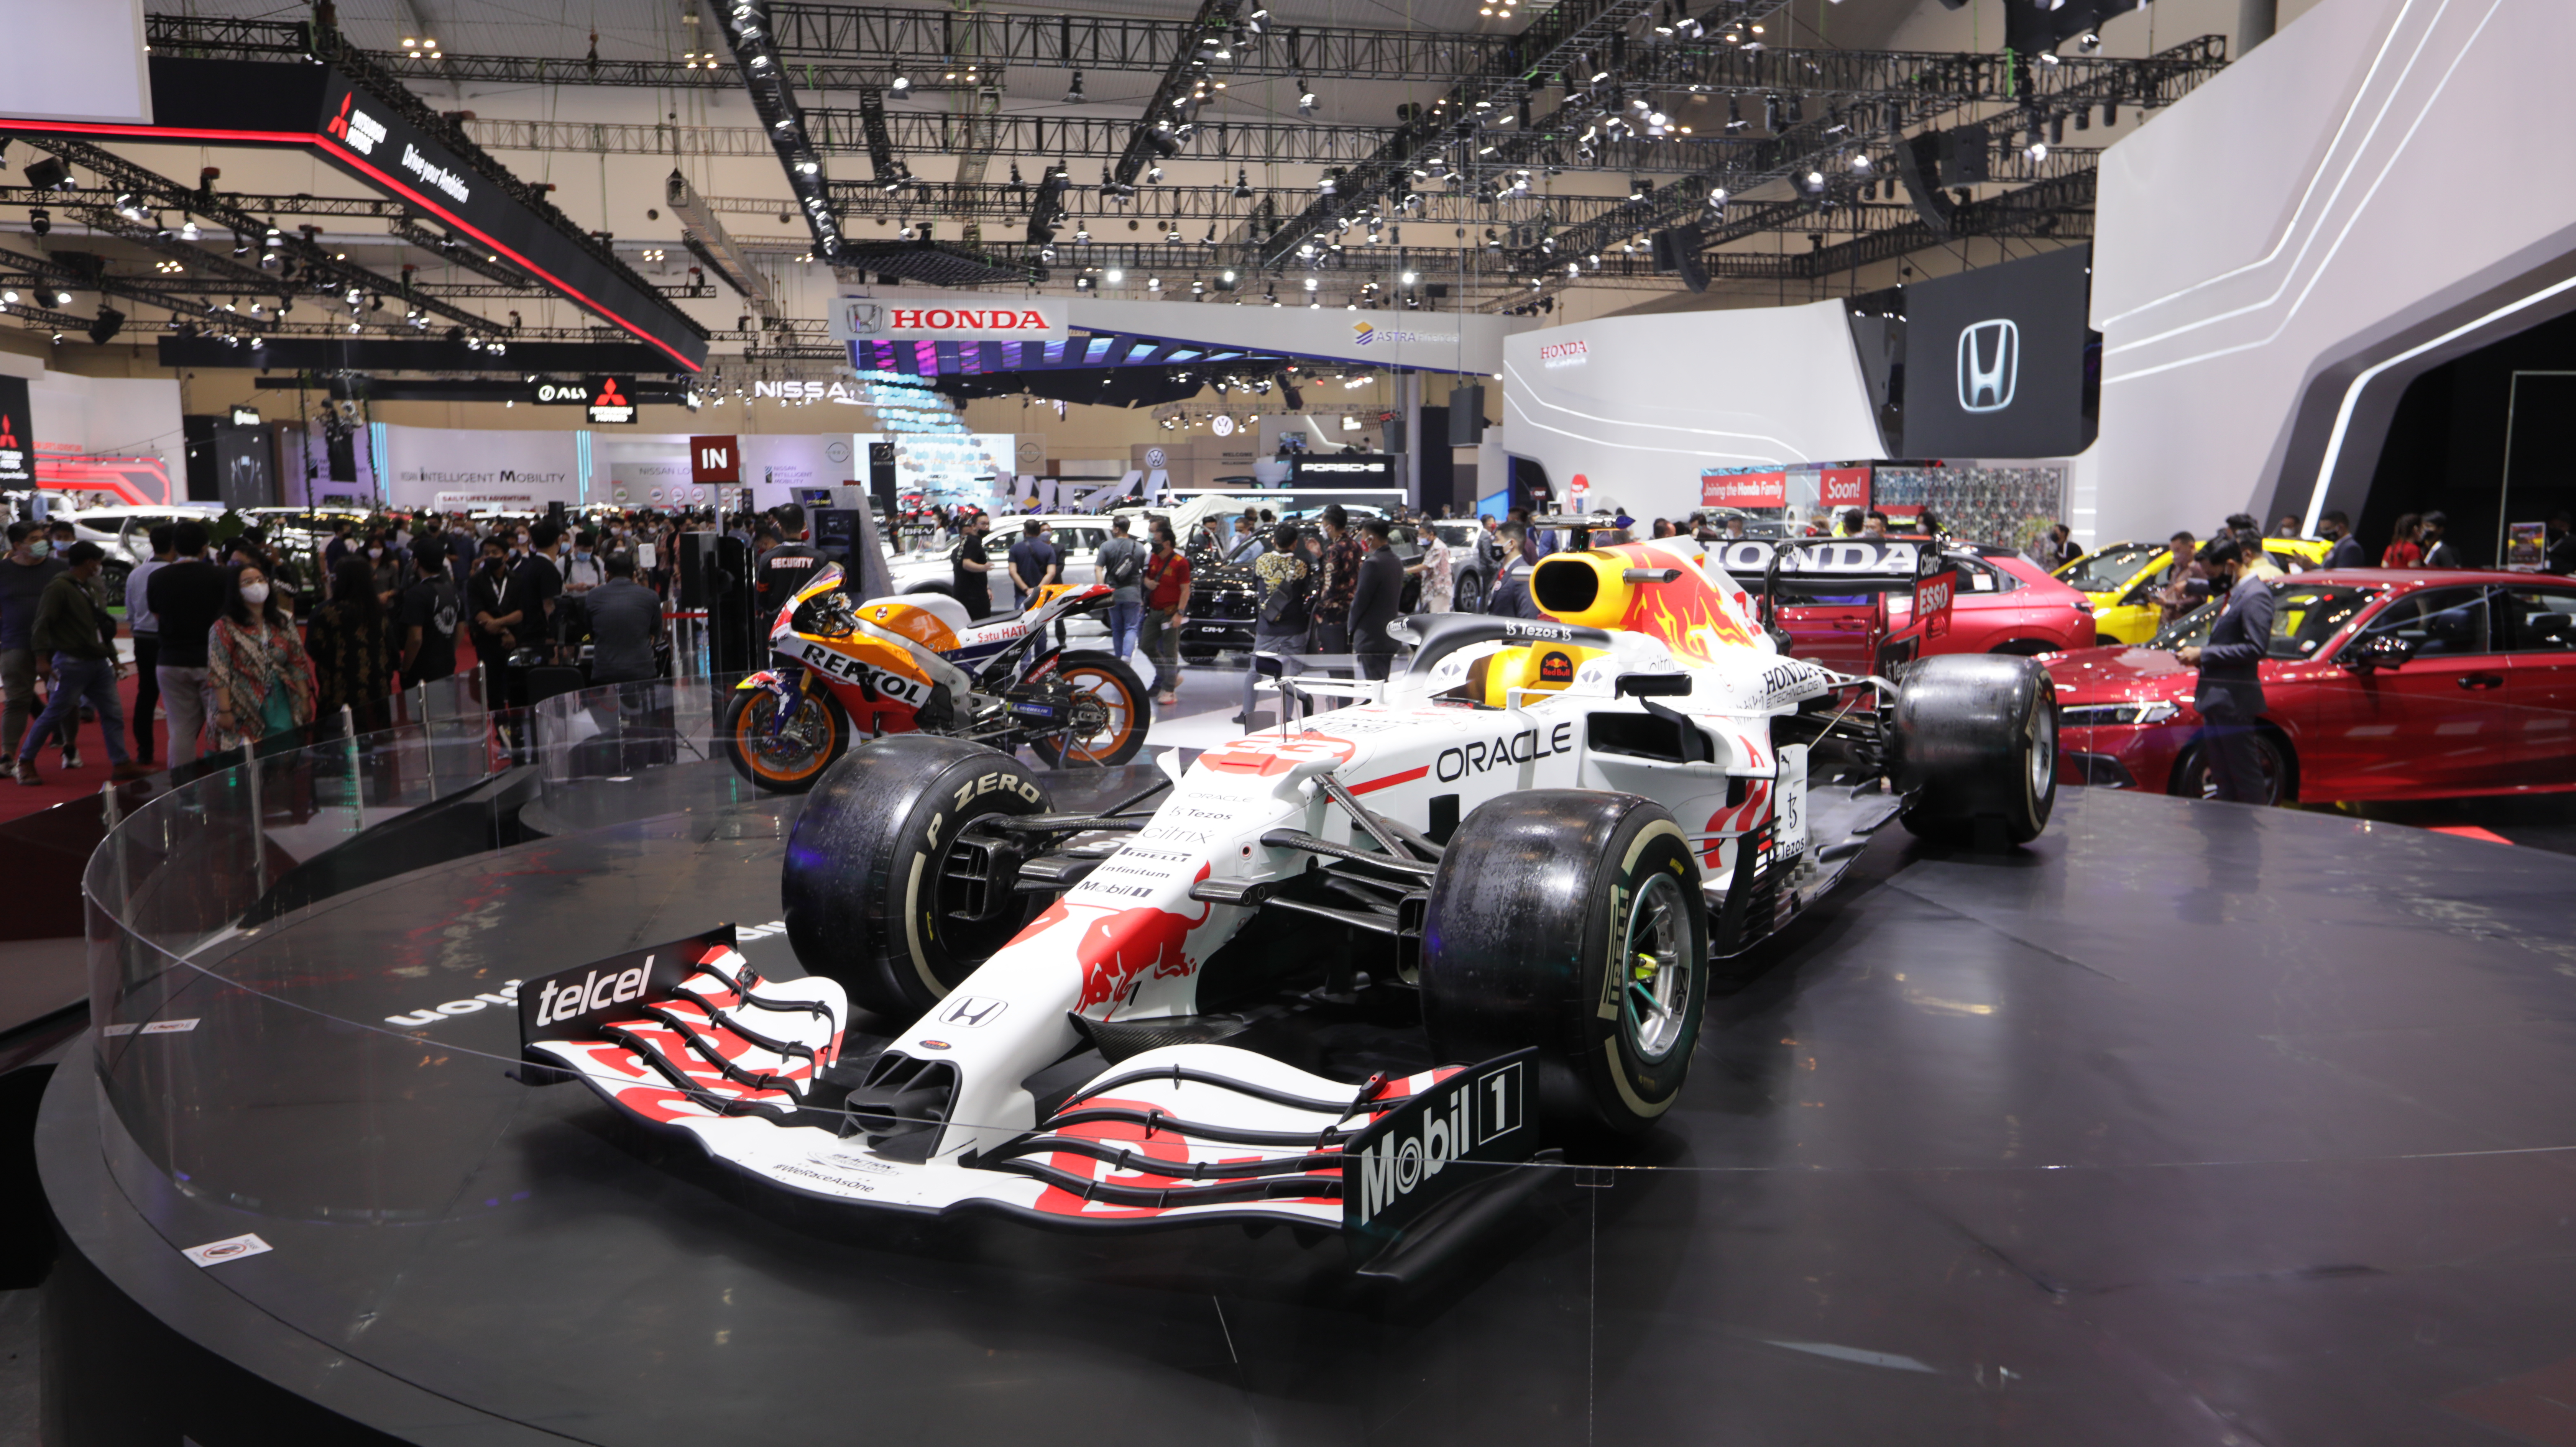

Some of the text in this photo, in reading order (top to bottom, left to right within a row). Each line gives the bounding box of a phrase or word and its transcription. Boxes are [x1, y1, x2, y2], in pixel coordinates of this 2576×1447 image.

[351, 109, 387, 143] MITSUBISHI
[345, 126, 374, 155] MOTORS
[402, 143, 469, 203] Drive your Ambition
[891, 310, 1050, 329] HONDA
[1376, 332, 1415, 341] ASTRA
[1541, 341, 1587, 359] HONDA
[754, 381, 854, 398] NISSA
[702, 448, 727, 469] IN
[1301, 464, 1385, 472] PORSCHE
[420, 467, 495, 482] INTELLIGENT
[500, 471, 565, 483] MOBILITY
[1704, 479, 1783, 500] Joining the Honda Family
[1827, 476, 1861, 499] Soon!
[771, 557, 814, 569] SECURITY
[978, 632, 999, 643] Satu
[1520, 623, 1558, 638] Tezos
[1762, 660, 1819, 695] HONDA
[1893, 659, 1911, 681] Tezo
[1437, 722, 1572, 783] ORACLE
[1189, 792, 1255, 803] ORACLE
[927, 772, 1040, 850] P ZERO
[1187, 809, 1233, 820] Tezos
[1142, 826, 1214, 844] citrix
[1119, 847, 1192, 862] PIRELLI
[1101, 865, 1170, 878] infinitum
[1078, 881, 1134, 895] Mobil
[1597, 884, 1629, 1021] PIRELLI
[537, 955, 654, 1027] telcel
[1362, 1084, 1470, 1227] Mobil
[772, 1164, 874, 1193] #WeRaceAsOne
